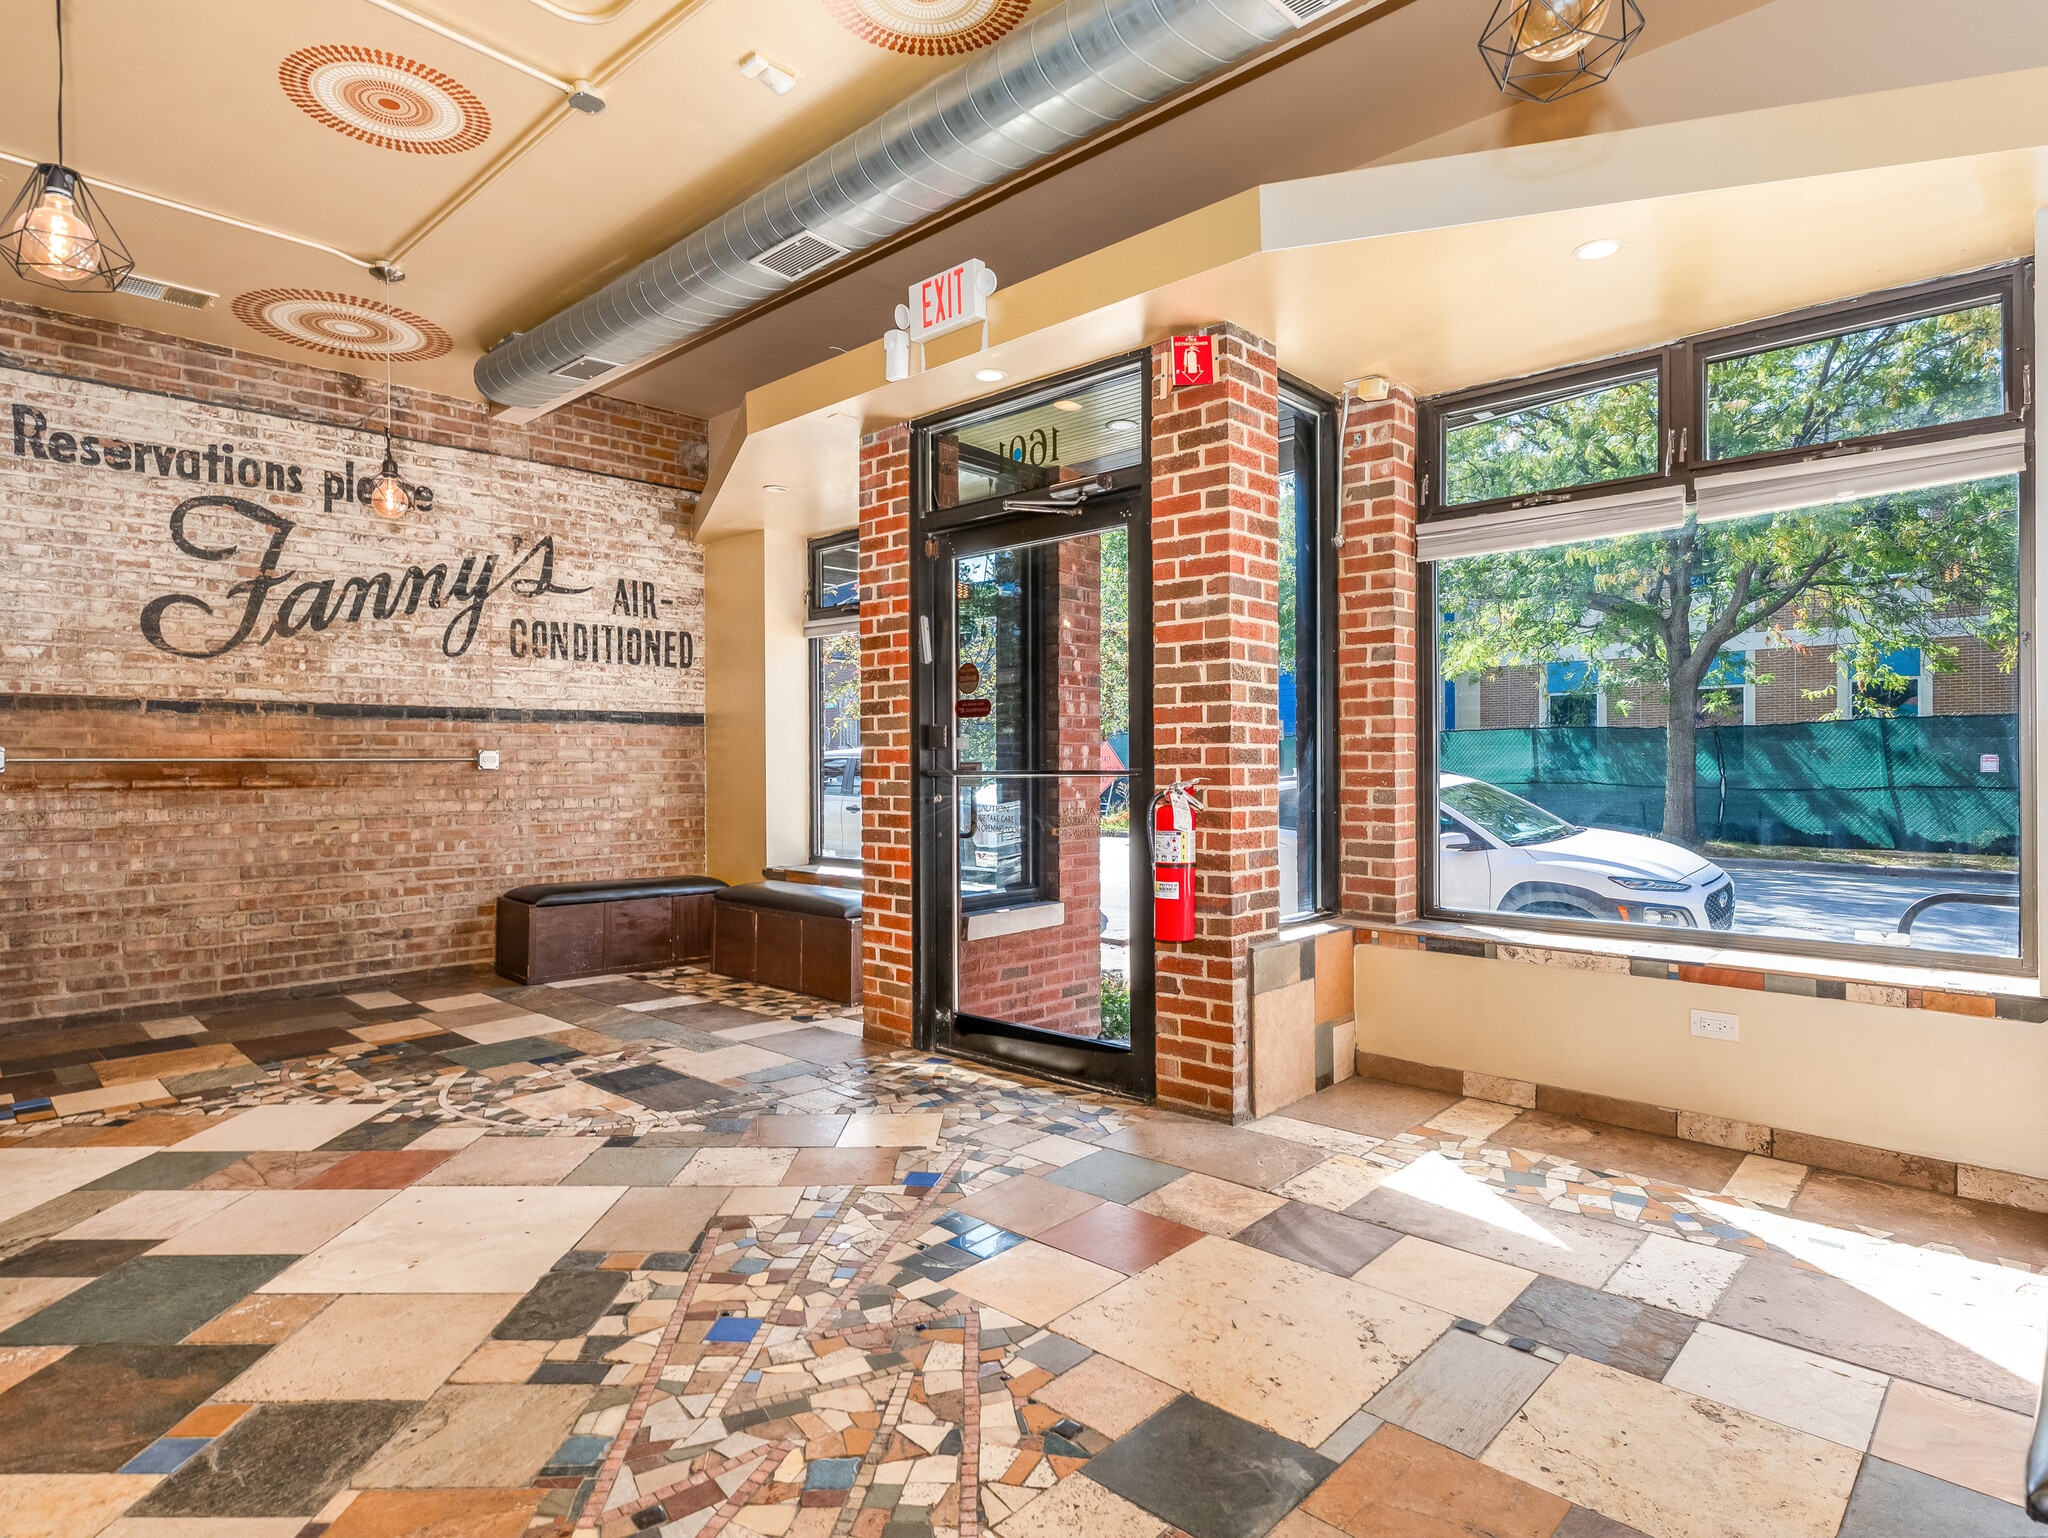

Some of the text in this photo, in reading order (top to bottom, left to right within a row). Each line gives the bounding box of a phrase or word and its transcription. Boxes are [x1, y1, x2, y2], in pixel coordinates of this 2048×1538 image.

[921, 266, 964, 329] EXIT
[11, 403, 434, 513] Reservations plee
[139, 494, 593, 658] Fanny's
[611, 578, 674, 620] AIR-
[509, 618, 694, 669] CONDITIONED
